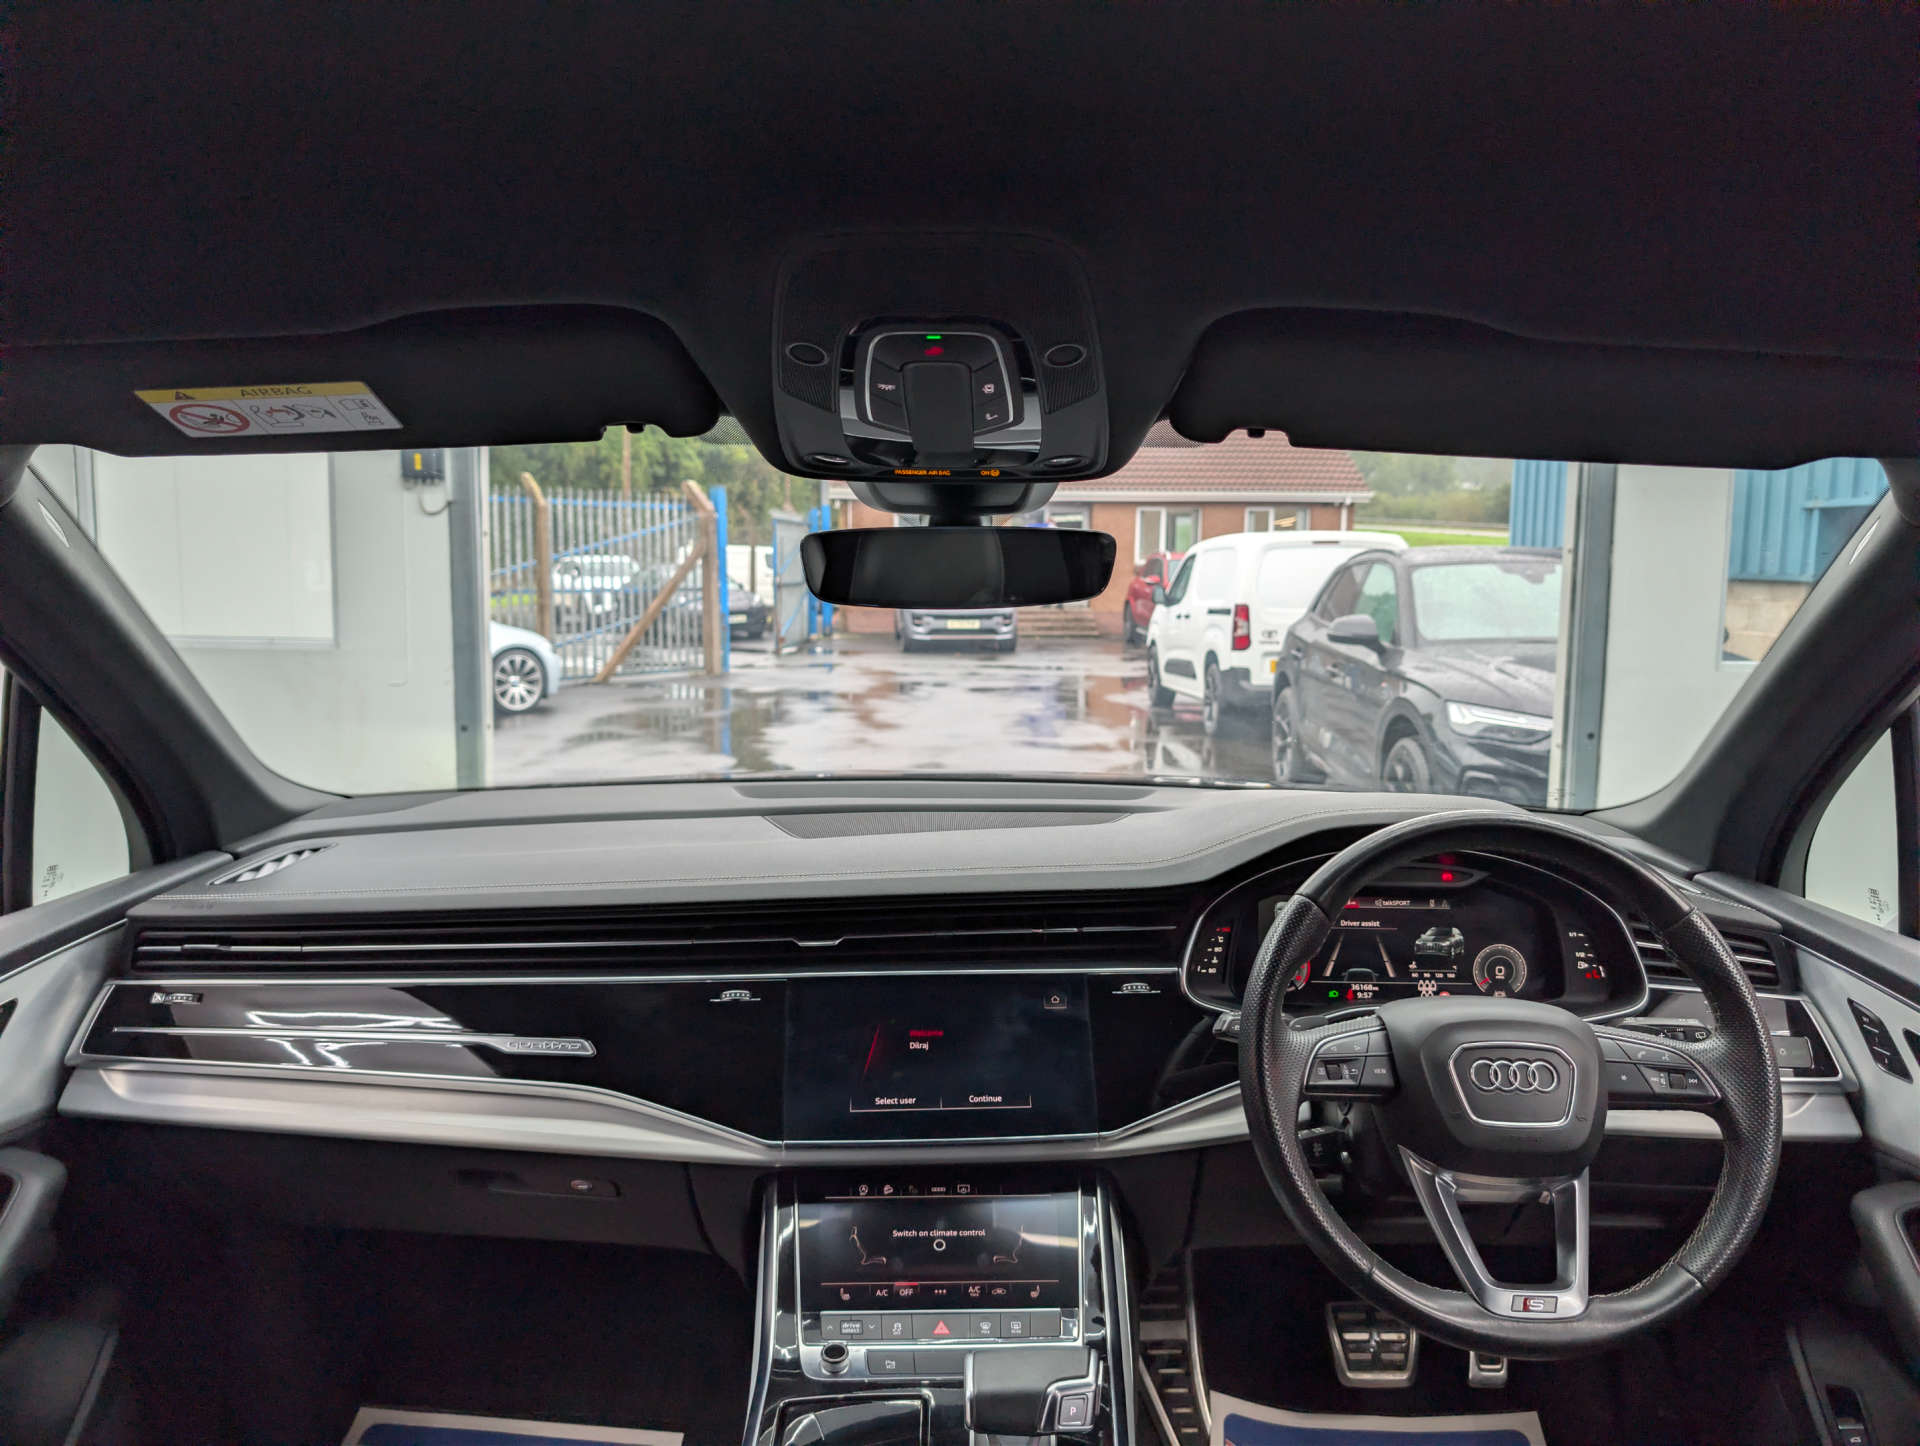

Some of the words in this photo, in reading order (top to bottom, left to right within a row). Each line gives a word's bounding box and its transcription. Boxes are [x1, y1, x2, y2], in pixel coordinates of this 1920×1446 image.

[240, 386, 312, 397] AIRBAG
[1340, 919, 1360, 927] Driver
[1361, 919, 1380, 927] assist
[1356, 991, 1373, 999] 9:57
[909, 1041, 929, 1051] Dilraj
[875, 1096, 899, 1105] Select
[900, 1097, 916, 1105] user
[968, 1094, 1003, 1103] Continue
[892, 1229, 917, 1237] Switch
[929, 1229, 958, 1237] climate
[958, 1229, 986, 1237] control
[875, 1288, 889, 1297] A/C
[899, 1288, 914, 1296] OFF
[967, 1286, 981, 1294] A/C
[1528, 1298, 1545, 1311] S
[1069, 1406, 1077, 1416] P
